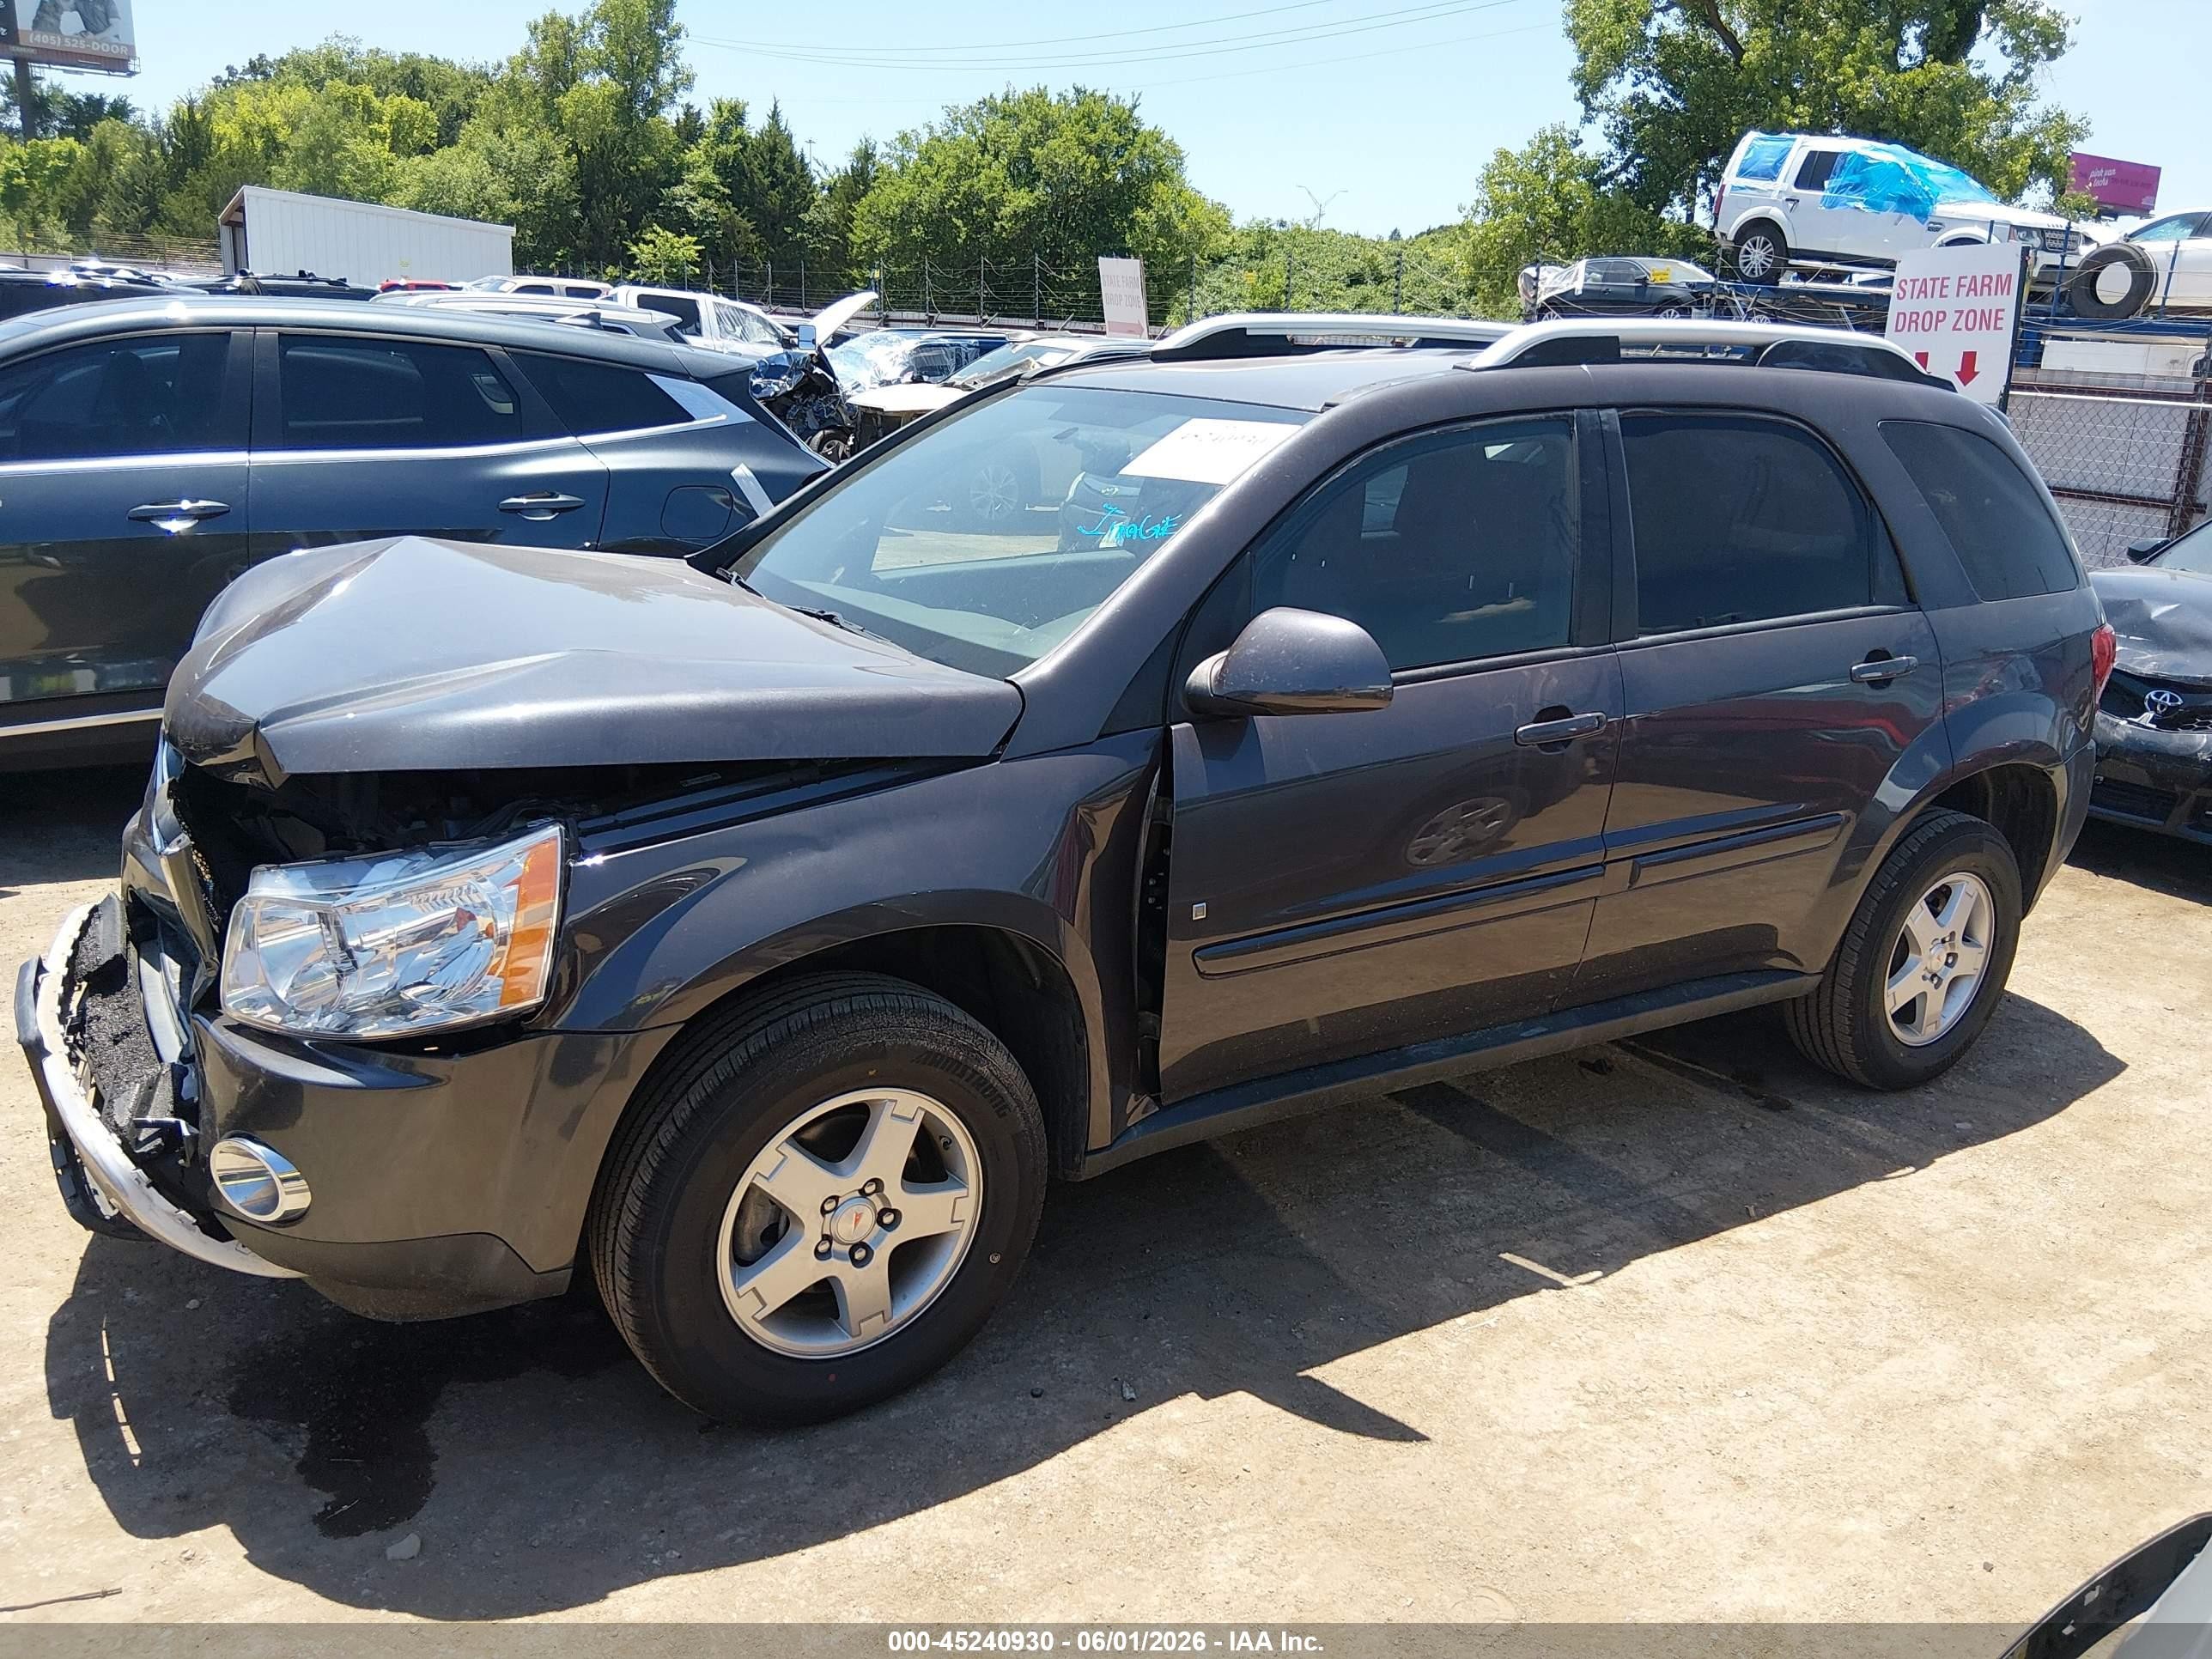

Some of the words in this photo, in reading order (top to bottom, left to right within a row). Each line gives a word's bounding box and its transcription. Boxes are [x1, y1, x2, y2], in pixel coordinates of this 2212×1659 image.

[29, 33, 61, 47] (405)
[64, 38, 128, 55] 525-DOOR
[1103, 275, 1121, 288] STATE
[1121, 276, 1139, 289] FARM
[1896, 276, 1950, 301] STATE
[1955, 273, 2013, 298] FARM
[1105, 293, 1123, 307] DROP
[1125, 295, 1141, 308] ZONE
[1894, 310, 1948, 333] DROP
[1952, 308, 2005, 331] ZONE
